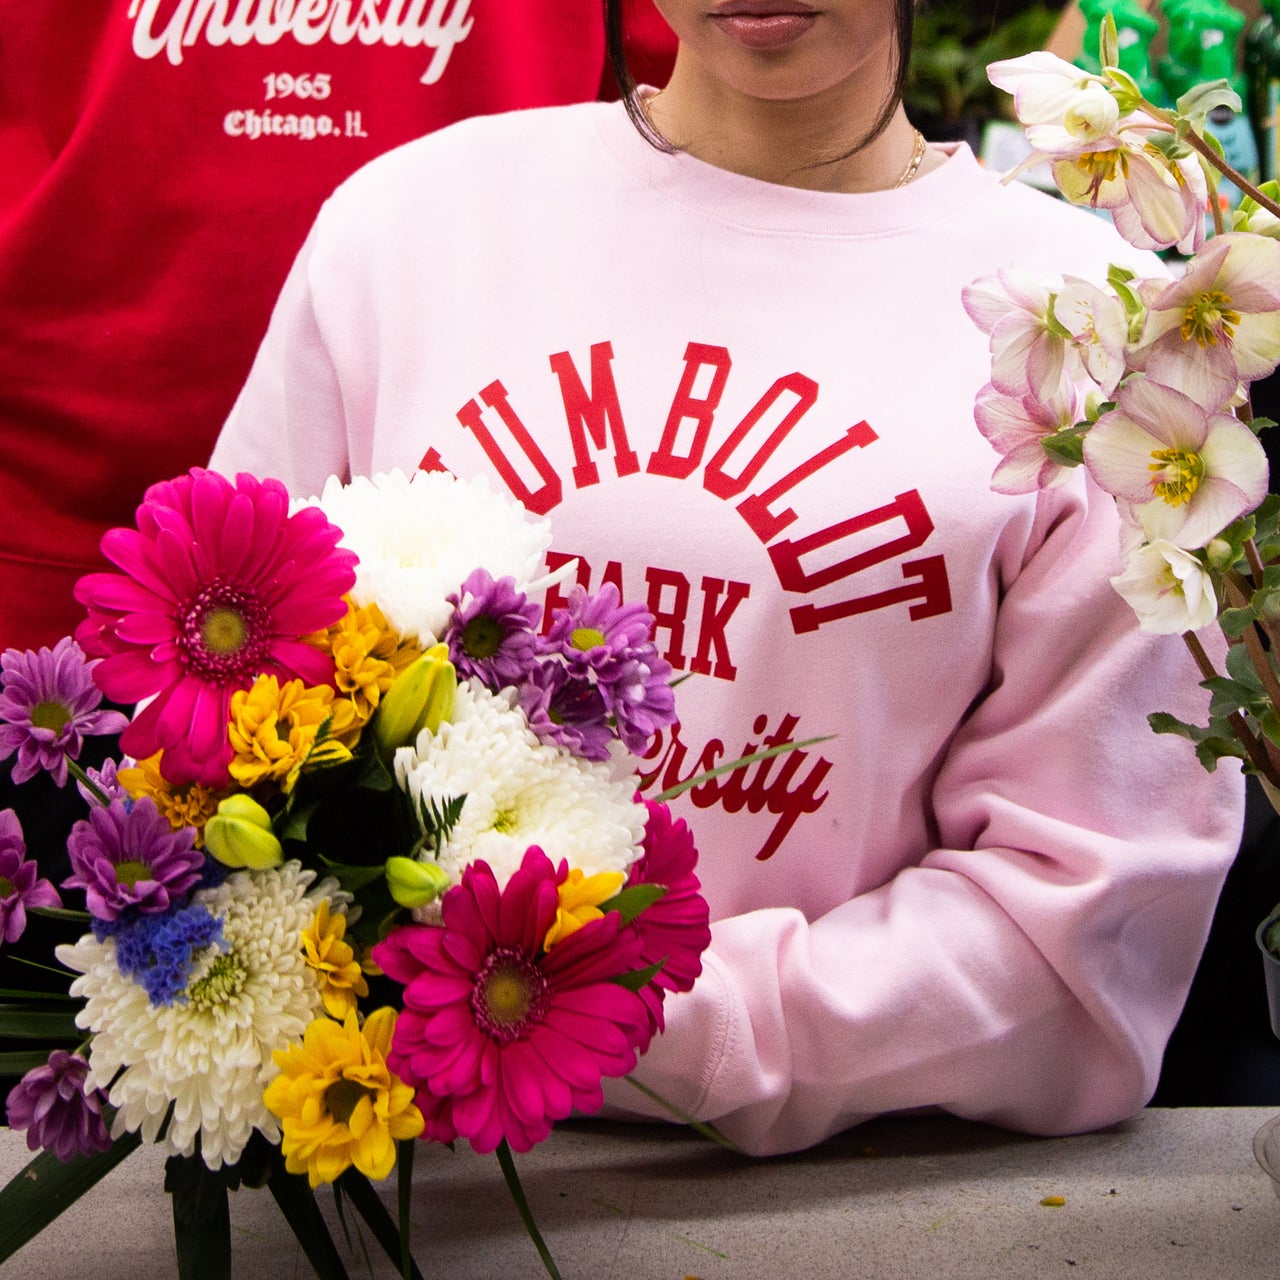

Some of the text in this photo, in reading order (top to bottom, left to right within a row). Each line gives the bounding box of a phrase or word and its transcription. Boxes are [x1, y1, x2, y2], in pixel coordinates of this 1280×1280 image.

[262, 72, 333, 101] 1965
[410, 340, 953, 635] UMBOLDT
[634, 712, 834, 862] ersity
